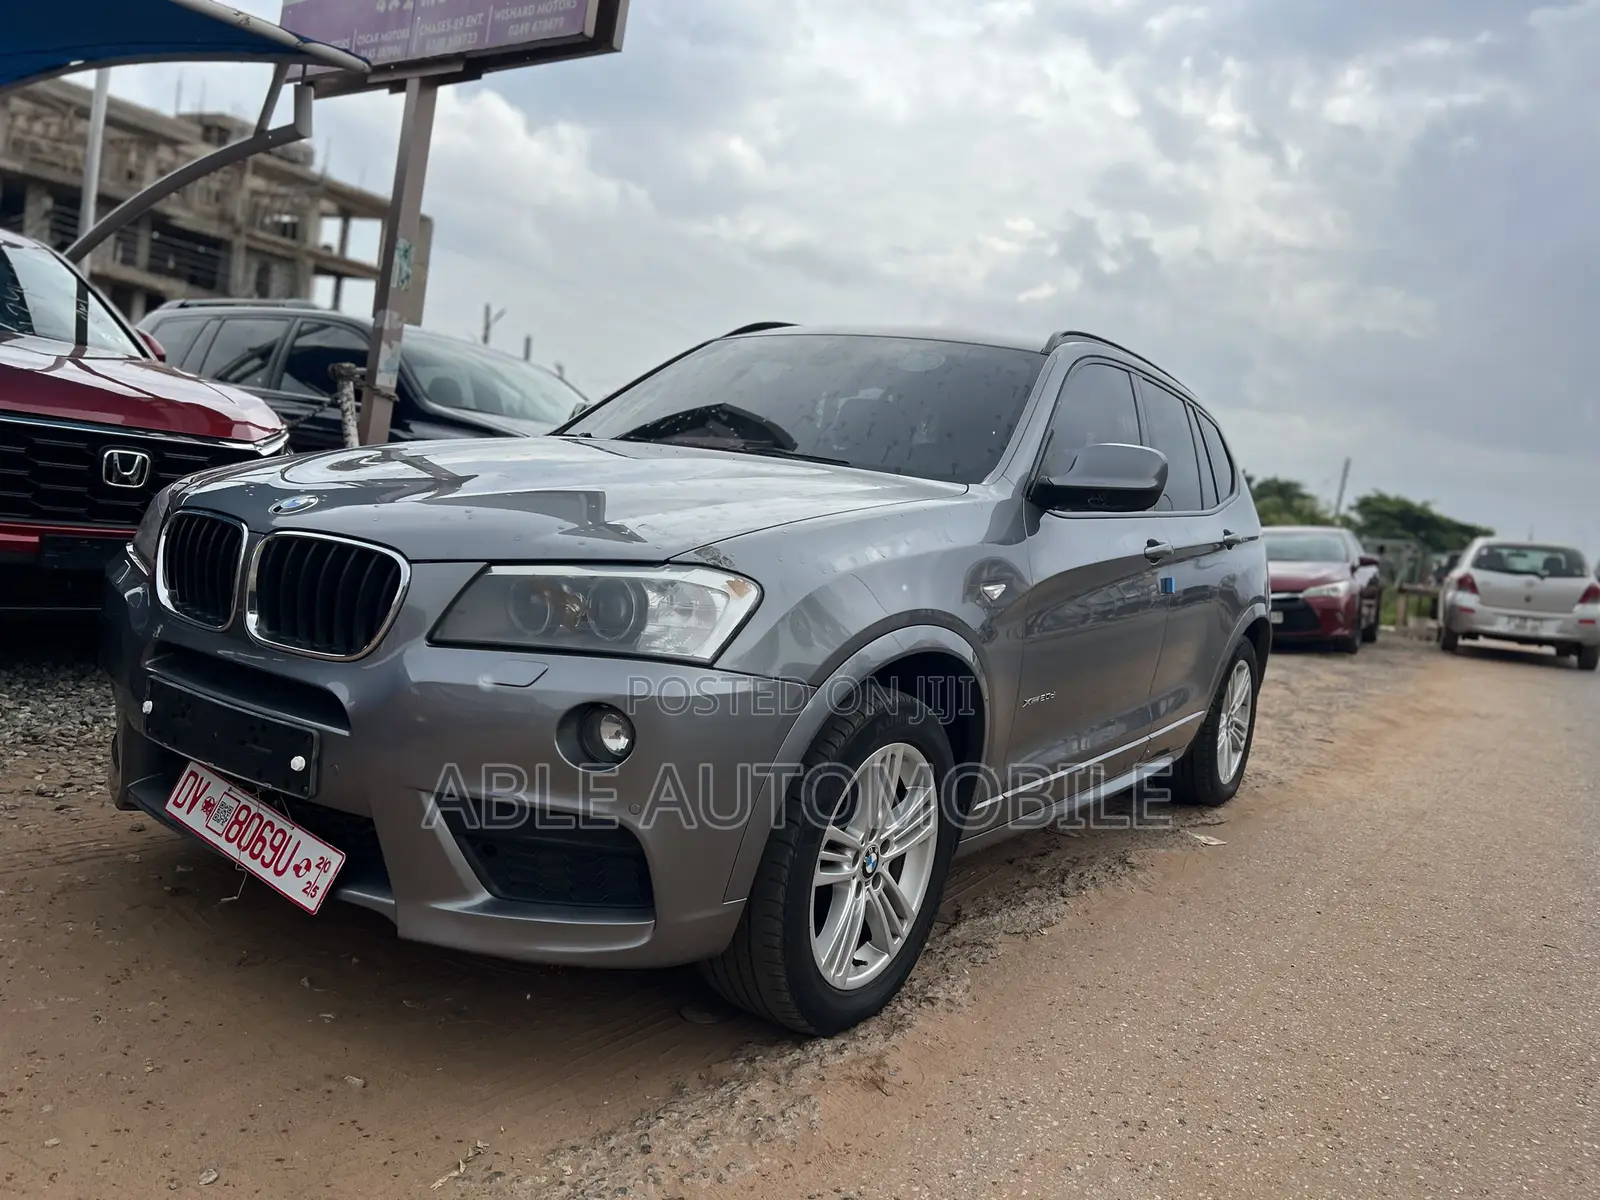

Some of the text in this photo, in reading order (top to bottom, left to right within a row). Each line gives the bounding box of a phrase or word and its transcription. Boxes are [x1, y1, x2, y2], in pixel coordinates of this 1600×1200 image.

[537, 0, 577, 15] MOTORS
[172, 769, 302, 877] DV 8069U
